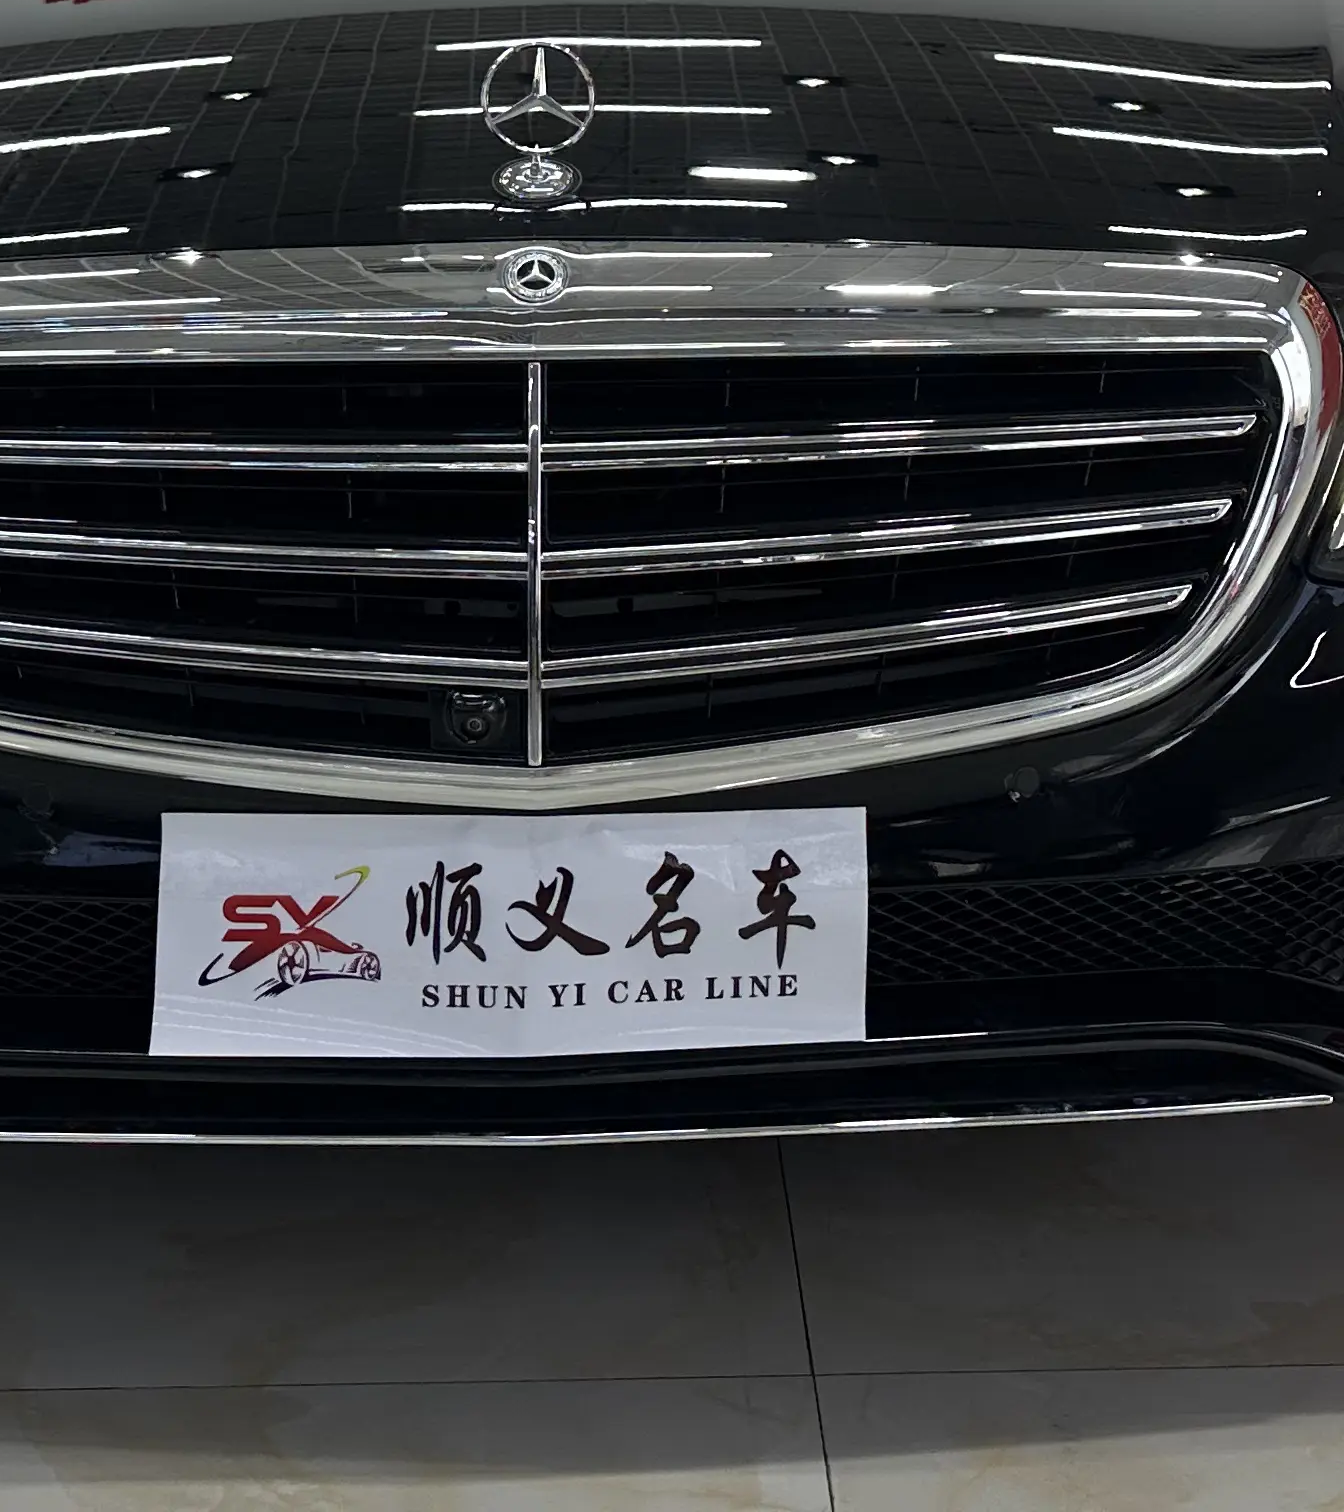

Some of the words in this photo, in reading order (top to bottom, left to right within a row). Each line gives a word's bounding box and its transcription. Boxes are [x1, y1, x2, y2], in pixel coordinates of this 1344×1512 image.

[405, 848, 817, 970] 顺义名车
[421, 983, 528, 1010] SHUN
[548, 982, 587, 1007] YI
[607, 977, 685, 1005] CAR
[705, 973, 799, 1001] LINE
